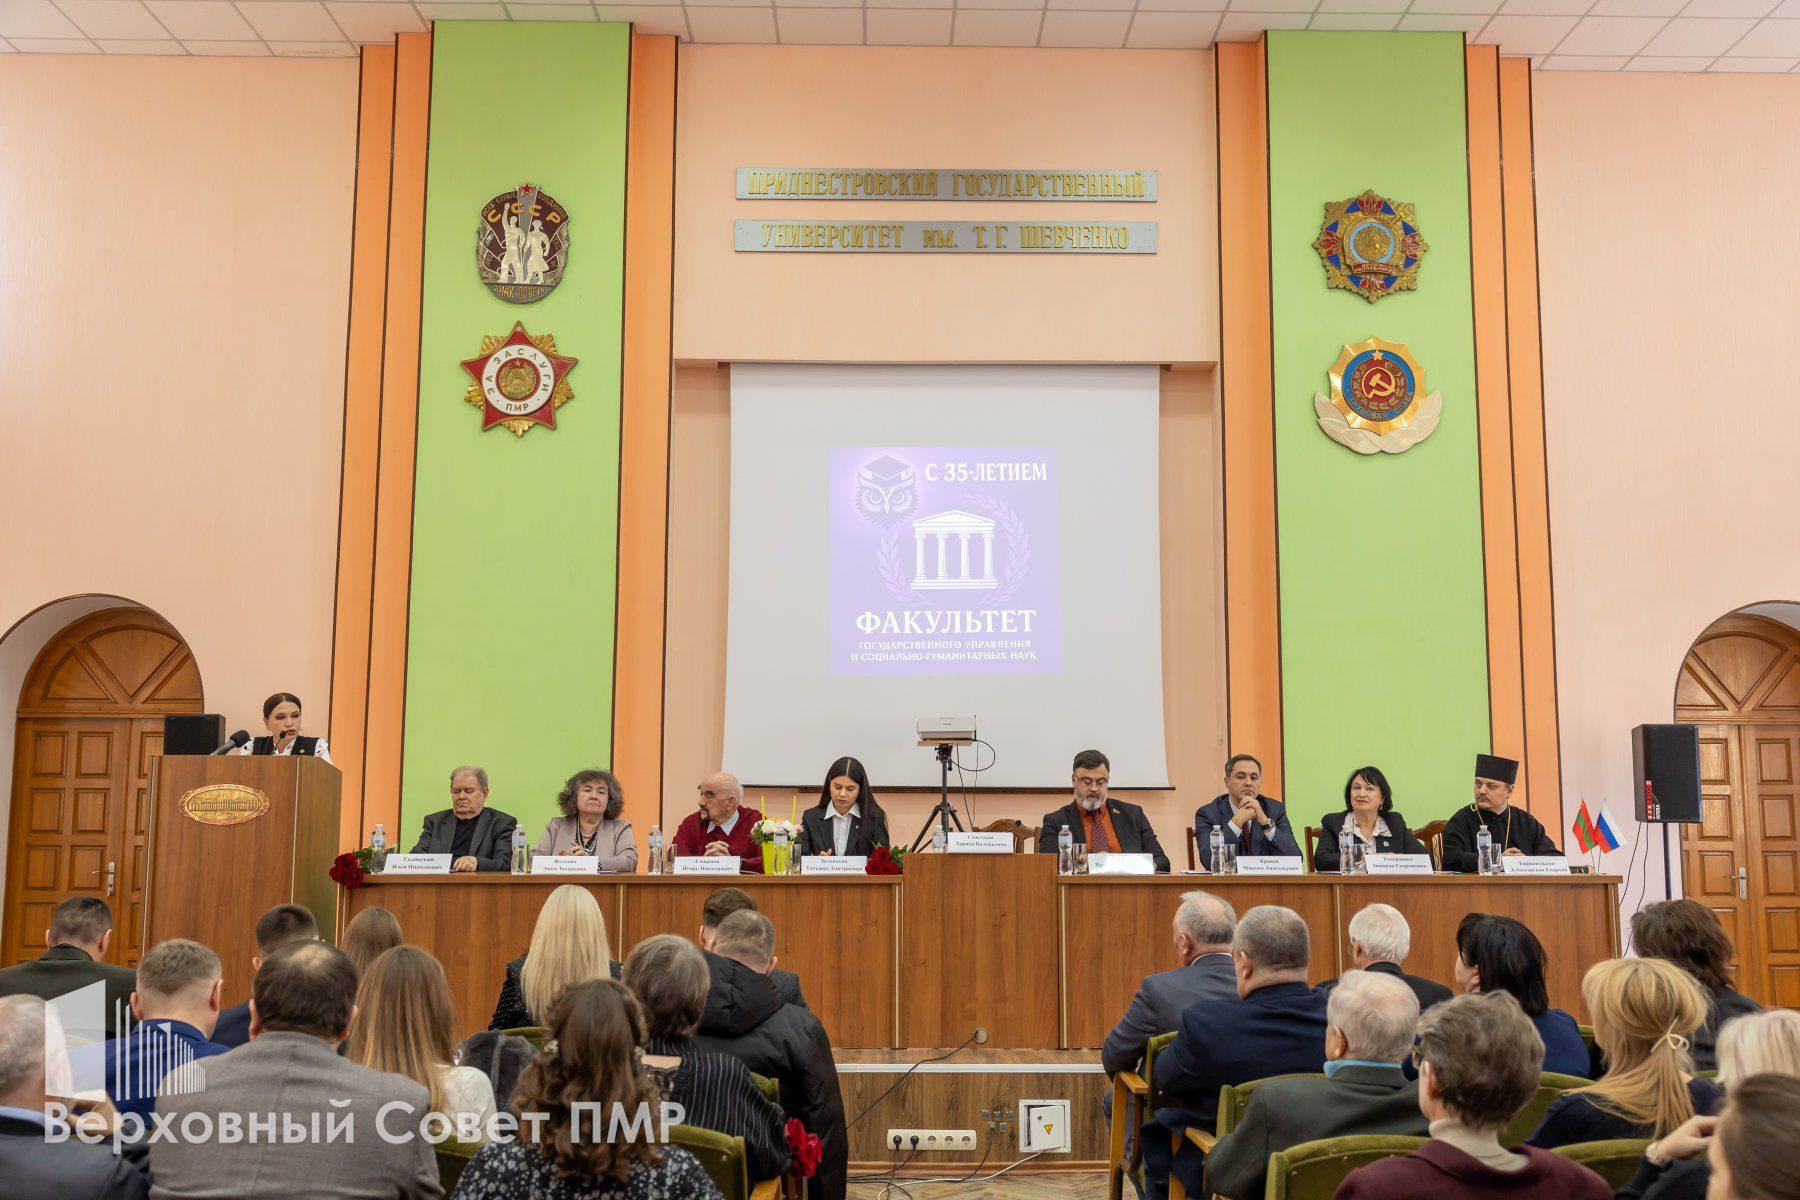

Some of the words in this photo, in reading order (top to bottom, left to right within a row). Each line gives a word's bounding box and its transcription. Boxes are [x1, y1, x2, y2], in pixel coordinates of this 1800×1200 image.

[747, 169, 939, 198] ПРИДНЕСТРОВСКИЙ
[951, 170, 1145, 199] ГОСУДАРСТВЕННЫЙ
[487, 201, 561, 224] СССР
[761, 223, 905, 249] УНИВЕРСИТЕТ
[1019, 225, 1131, 250] ШЕВЧЕНКО
[494, 348, 551, 392] ЗАСЛУГИ
[505, 403, 529, 411] ПМР
[924, 463, 938, 482] С
[943, 463, 1047, 482] 35-ЛЕТИЕМ
[856, 609, 1036, 634] ФАКУЛЬТЕТ
[859, 640, 962, 650] ГОСУДАРСТВЕННОГО
[965, 639, 1031, 649] УПРАВЛЕНИЯ
[851, 653, 858, 661] И
[861, 652, 1006, 662] СОЦИАЛЬНО-ГУМАНИТАРНЫХ
[1011, 651, 1037, 660] НАУК
